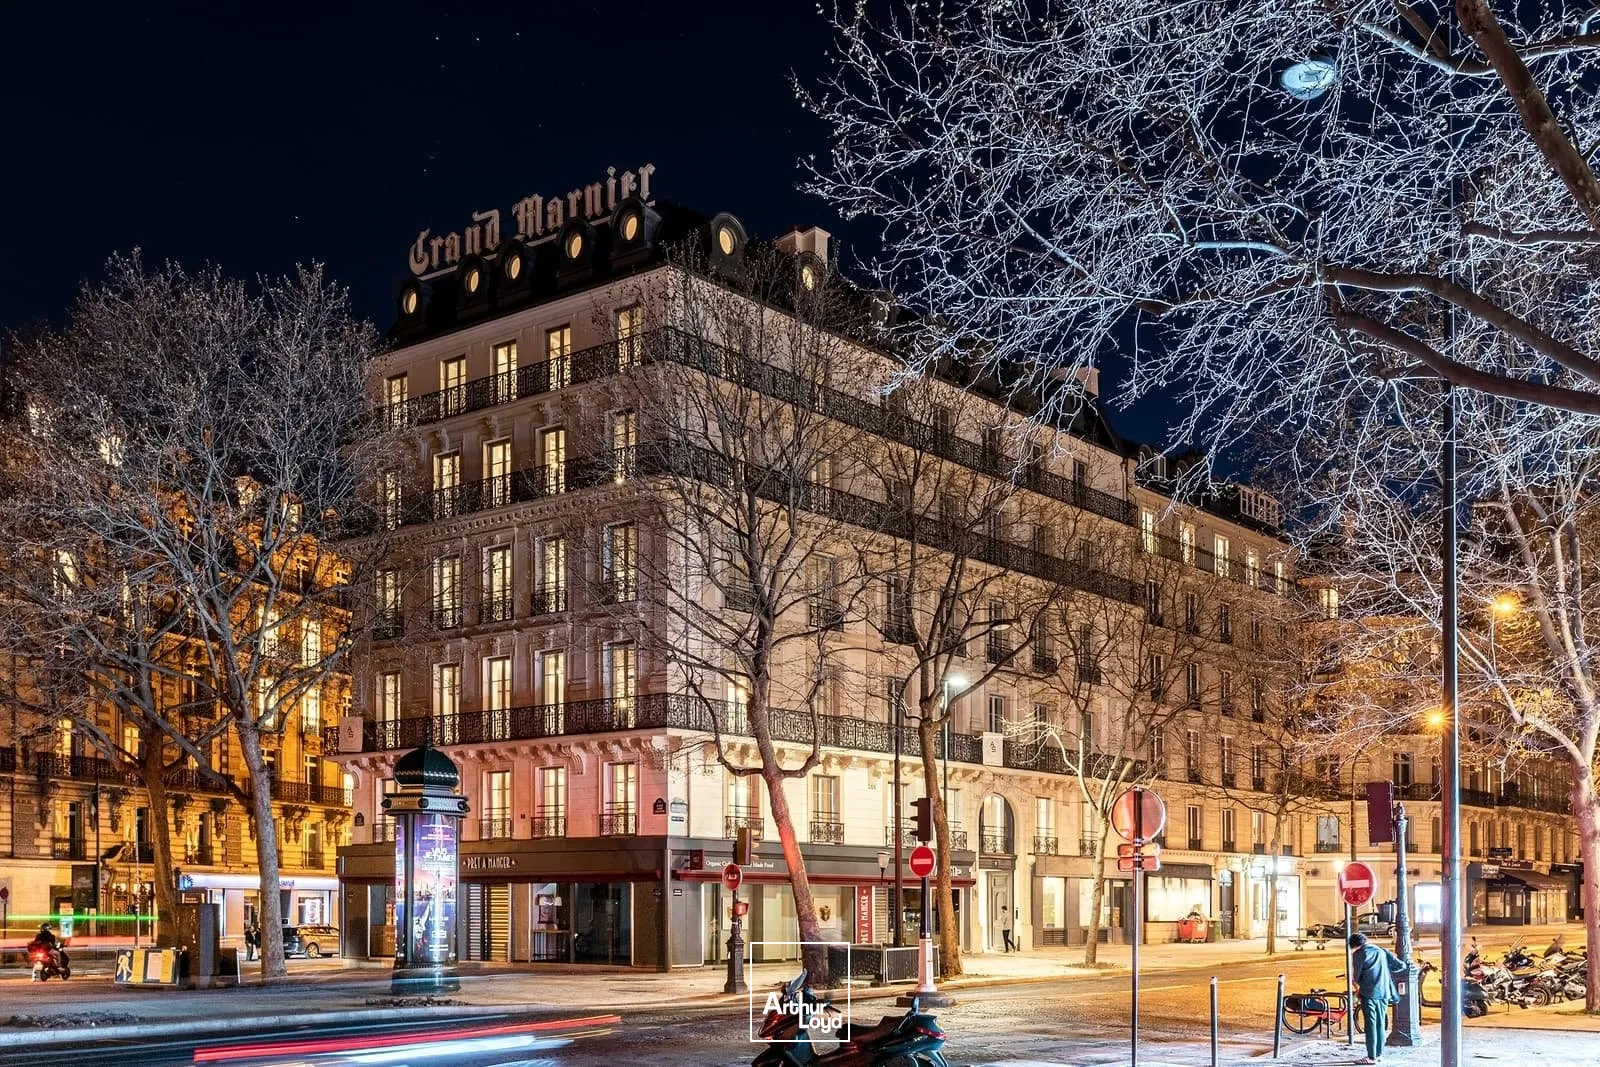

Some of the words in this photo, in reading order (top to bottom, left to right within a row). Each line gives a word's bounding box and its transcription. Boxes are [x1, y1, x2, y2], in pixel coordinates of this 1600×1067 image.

[408, 207, 500, 276] Grand
[512, 163, 656, 242] Marnier
[467, 856, 481, 869] PRET
[481, 856, 488, 869] A
[488, 856, 511, 869] MANGER
[860, 895, 869, 921] MANGER
